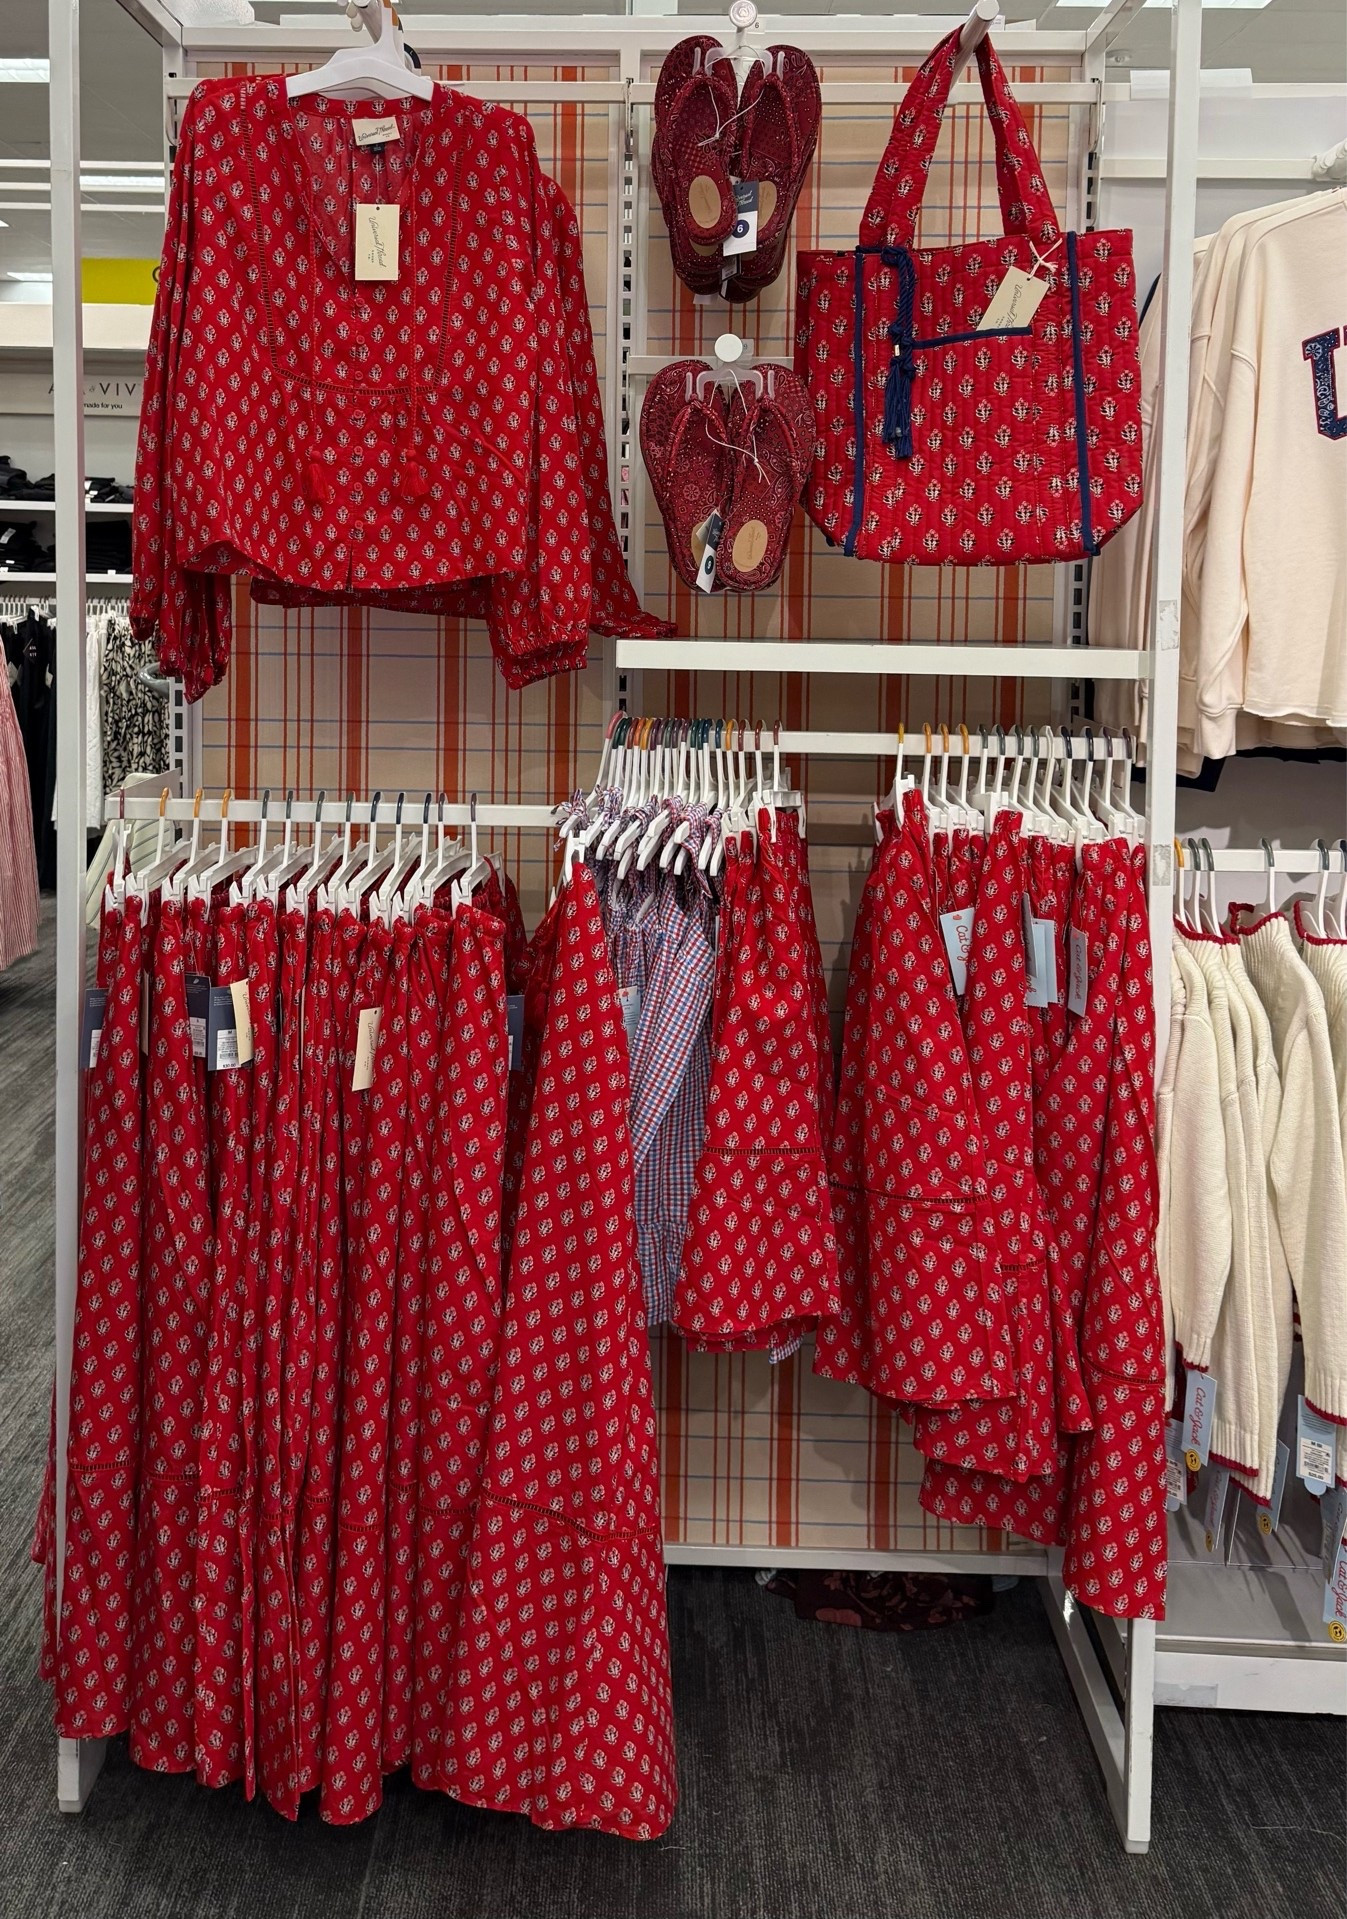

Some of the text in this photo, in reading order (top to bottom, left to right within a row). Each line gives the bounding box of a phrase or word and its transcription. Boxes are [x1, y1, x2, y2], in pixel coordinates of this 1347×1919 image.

[368, 216, 384, 246] Universal
[736, 224, 744, 233] 6
[373, 242, 387, 268] Thread
[956, 925, 969, 944] Cat
[1073, 972, 1083, 1000] Jack
[1189, 1387, 1207, 1446] Cat & Jack
[1331, 1560, 1347, 1617] Cat & Jack
